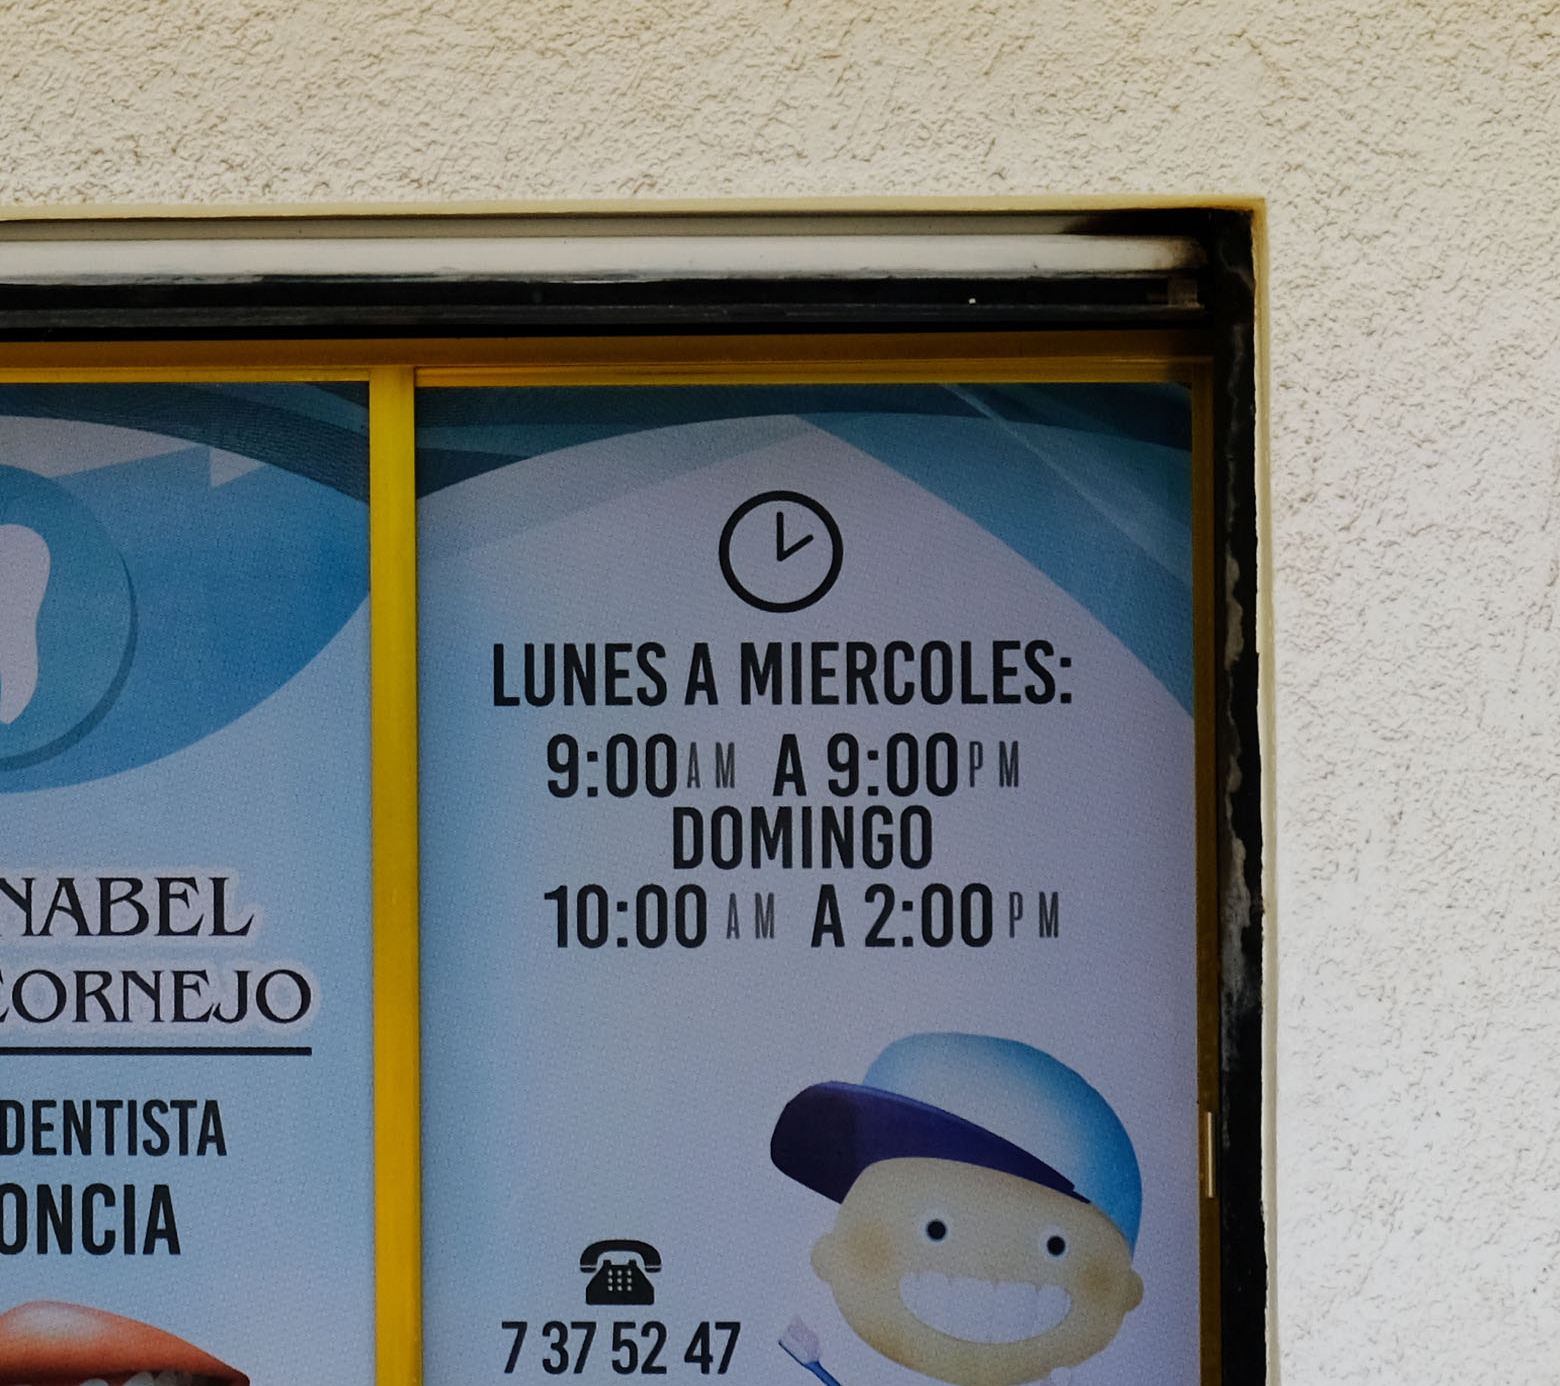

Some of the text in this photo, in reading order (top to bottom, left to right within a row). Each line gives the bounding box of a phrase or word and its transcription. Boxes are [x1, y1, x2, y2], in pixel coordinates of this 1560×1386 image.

[493, 639, 1072, 708] LUNES A MIERCOLES:
[772, 733, 807, 797] A
[672, 804, 933, 871] DOMINGO
[543, 883, 707, 949] 10:00
[810, 883, 845, 948] A
[864, 882, 993, 948] 2:00
[501, 1320, 741, 1375] 7 37 52 47
